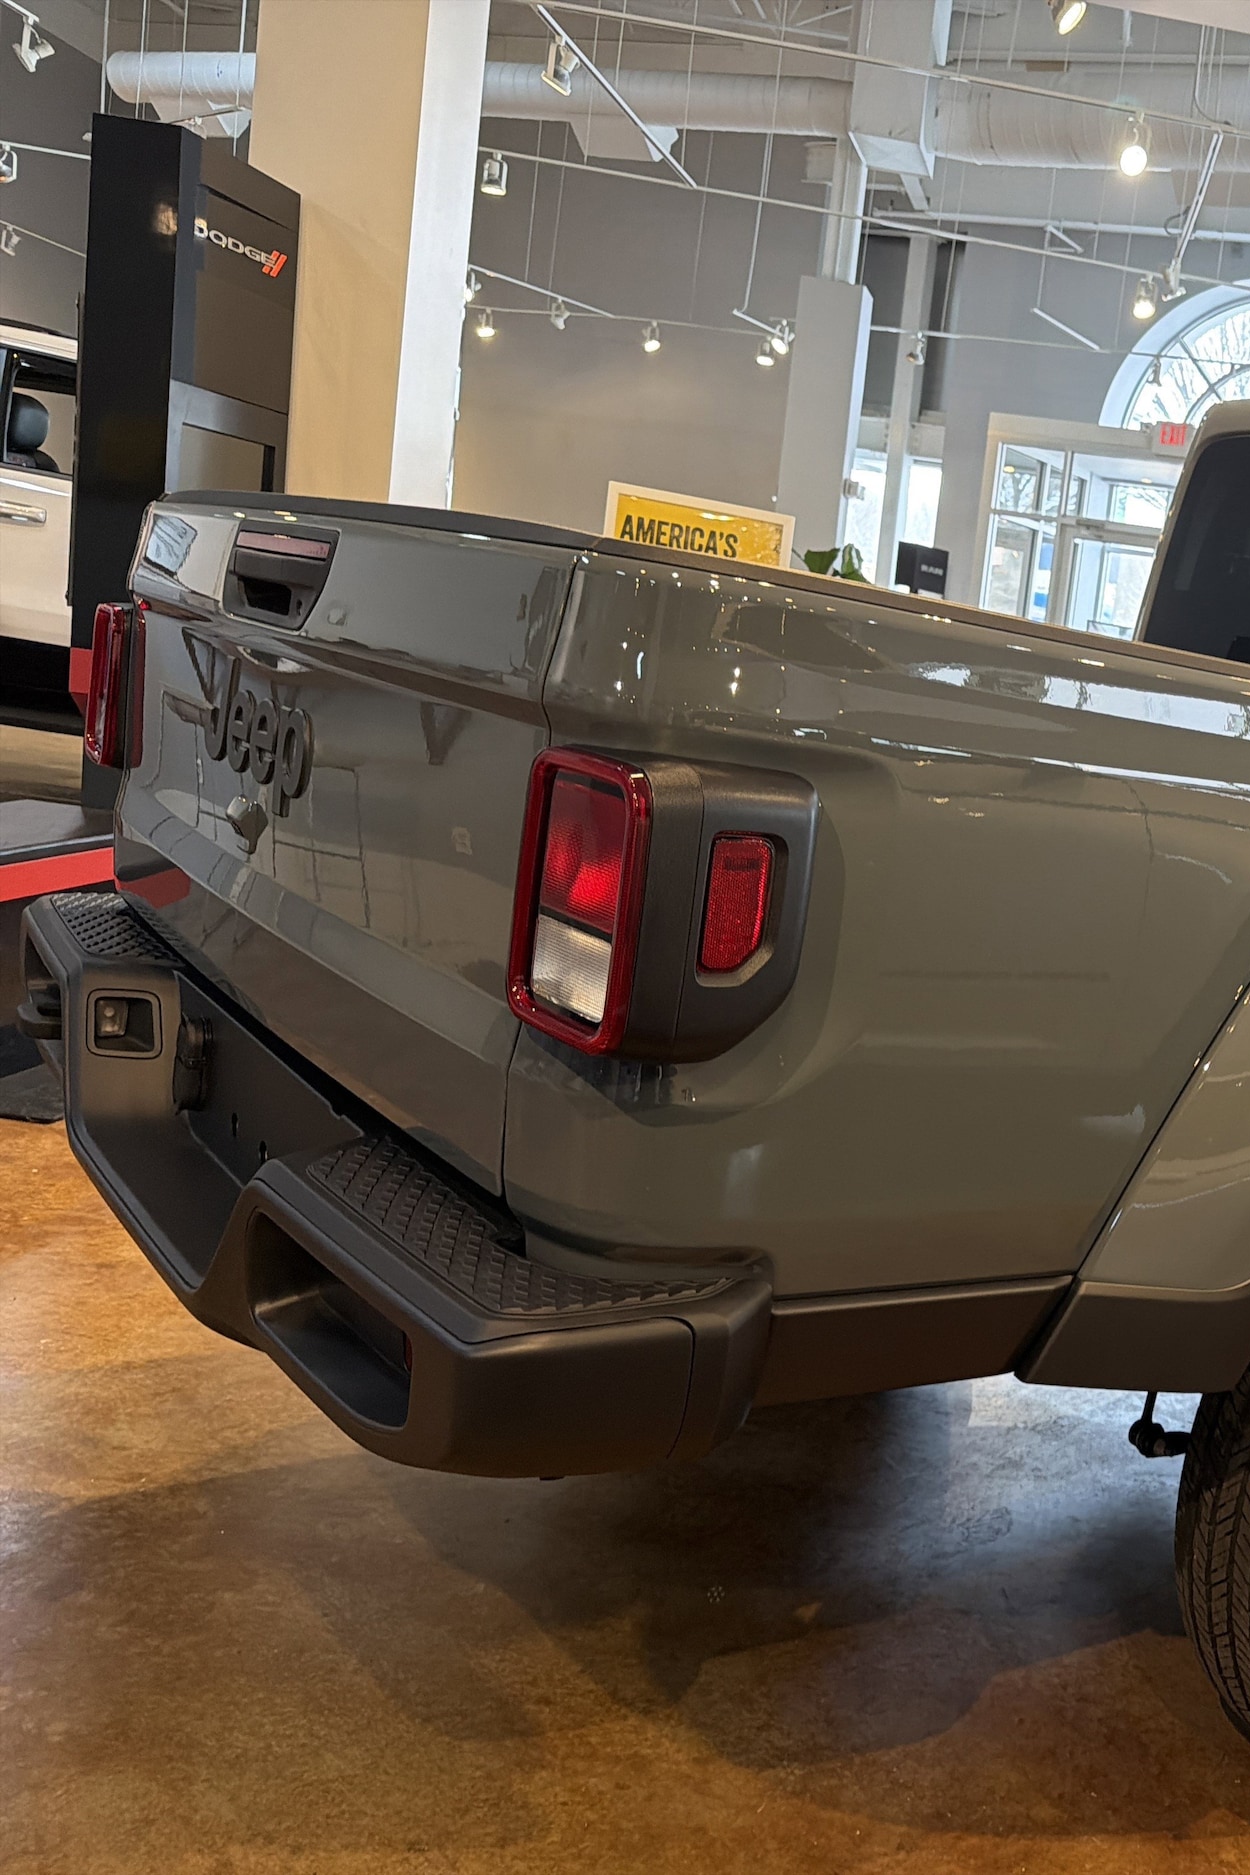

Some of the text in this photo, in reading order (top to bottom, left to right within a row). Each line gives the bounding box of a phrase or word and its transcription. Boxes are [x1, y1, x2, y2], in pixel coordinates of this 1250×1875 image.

[194, 217, 277, 268] DODGE
[1160, 422, 1188, 446] EXIT
[619, 514, 739, 559] AMERICA'S
[204, 655, 315, 817] Jeep
